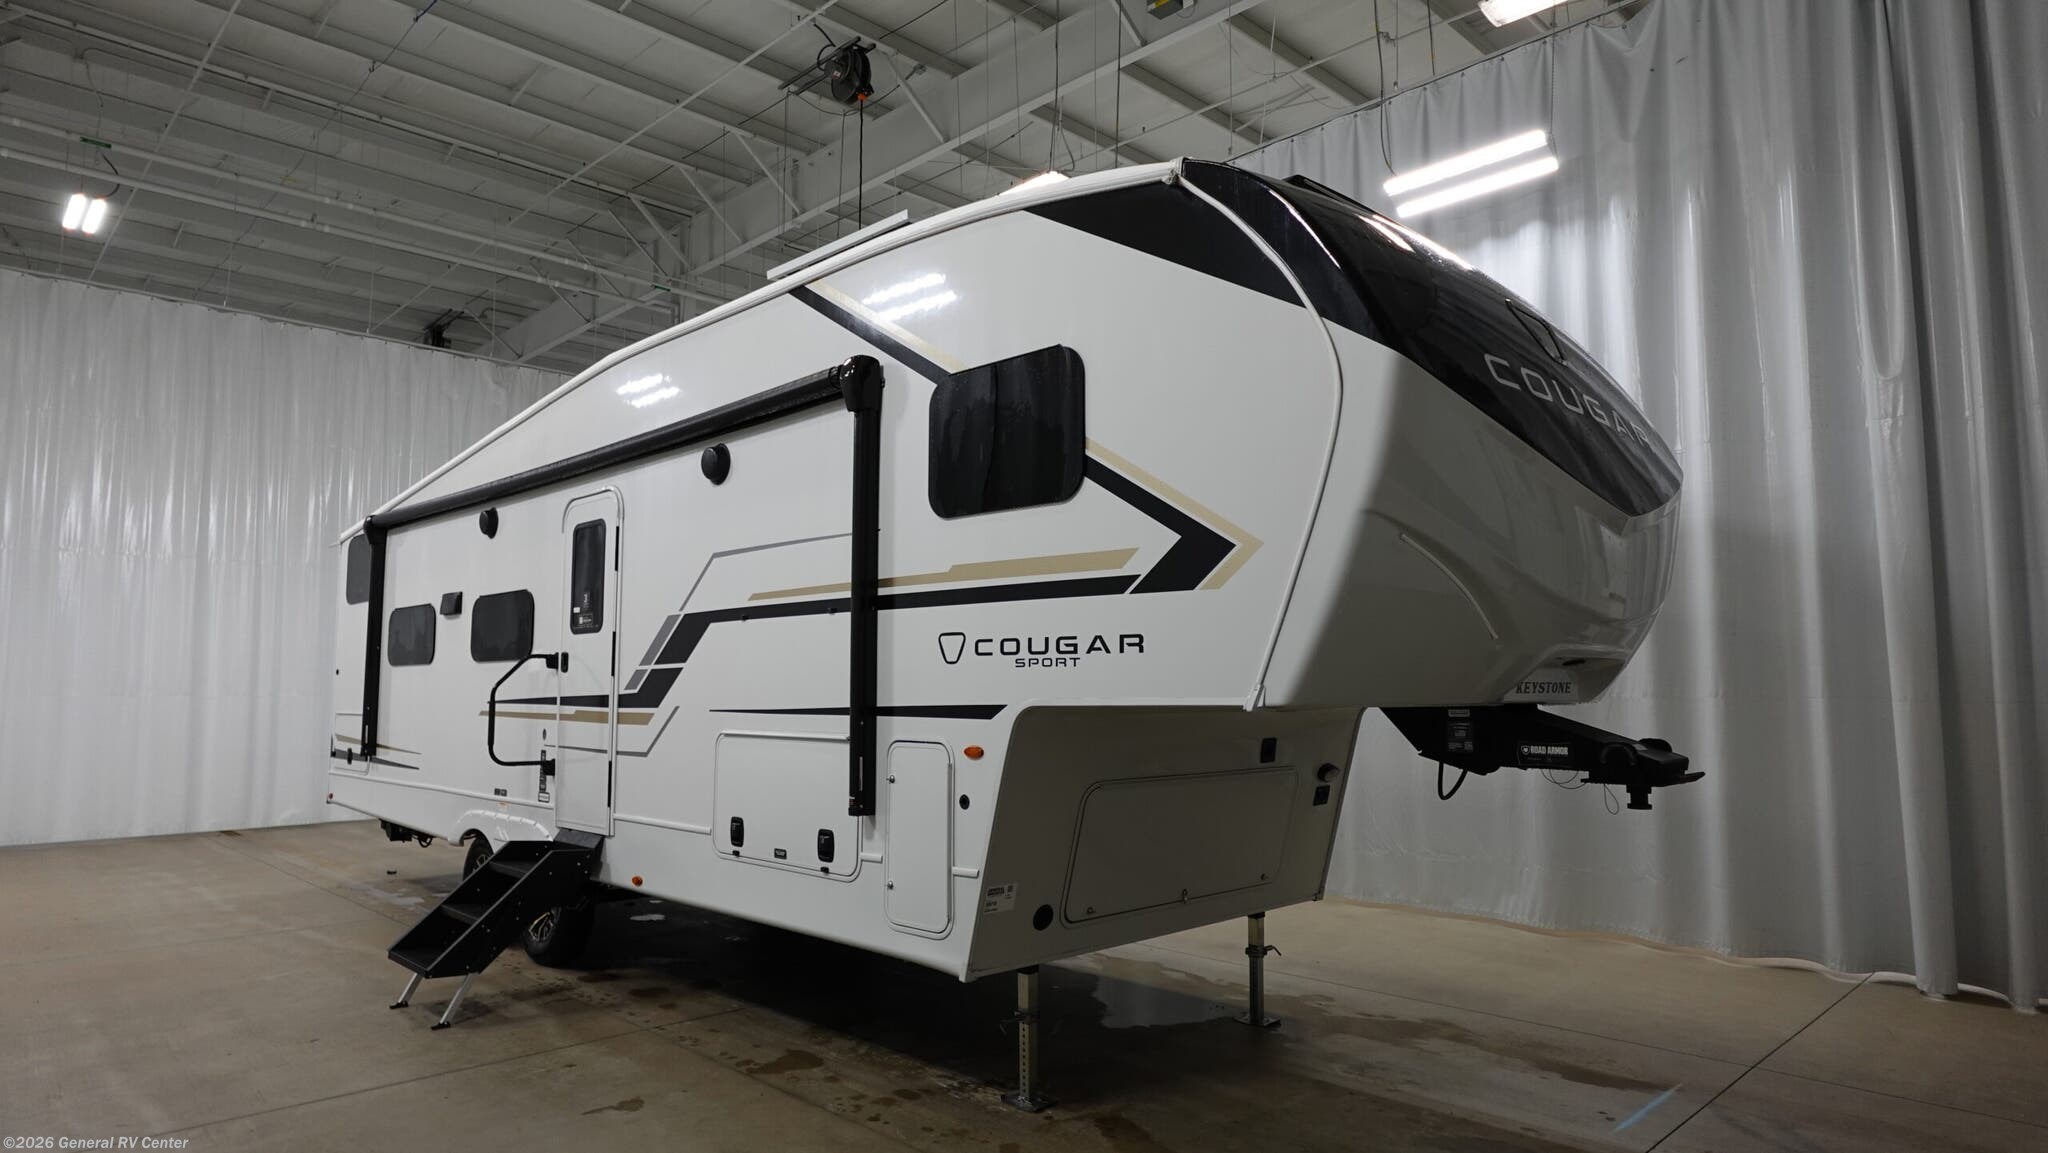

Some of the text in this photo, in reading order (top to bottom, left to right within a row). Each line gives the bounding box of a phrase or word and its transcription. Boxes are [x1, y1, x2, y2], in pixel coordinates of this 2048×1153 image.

[1484, 353, 1649, 446] COUGAR
[974, 634, 1145, 656] COUGAR
[1015, 657, 1081, 668] SPORT
[1515, 681, 1572, 694] KEYSTONE
[1530, 745, 1569, 755] ROAD ARMOR
